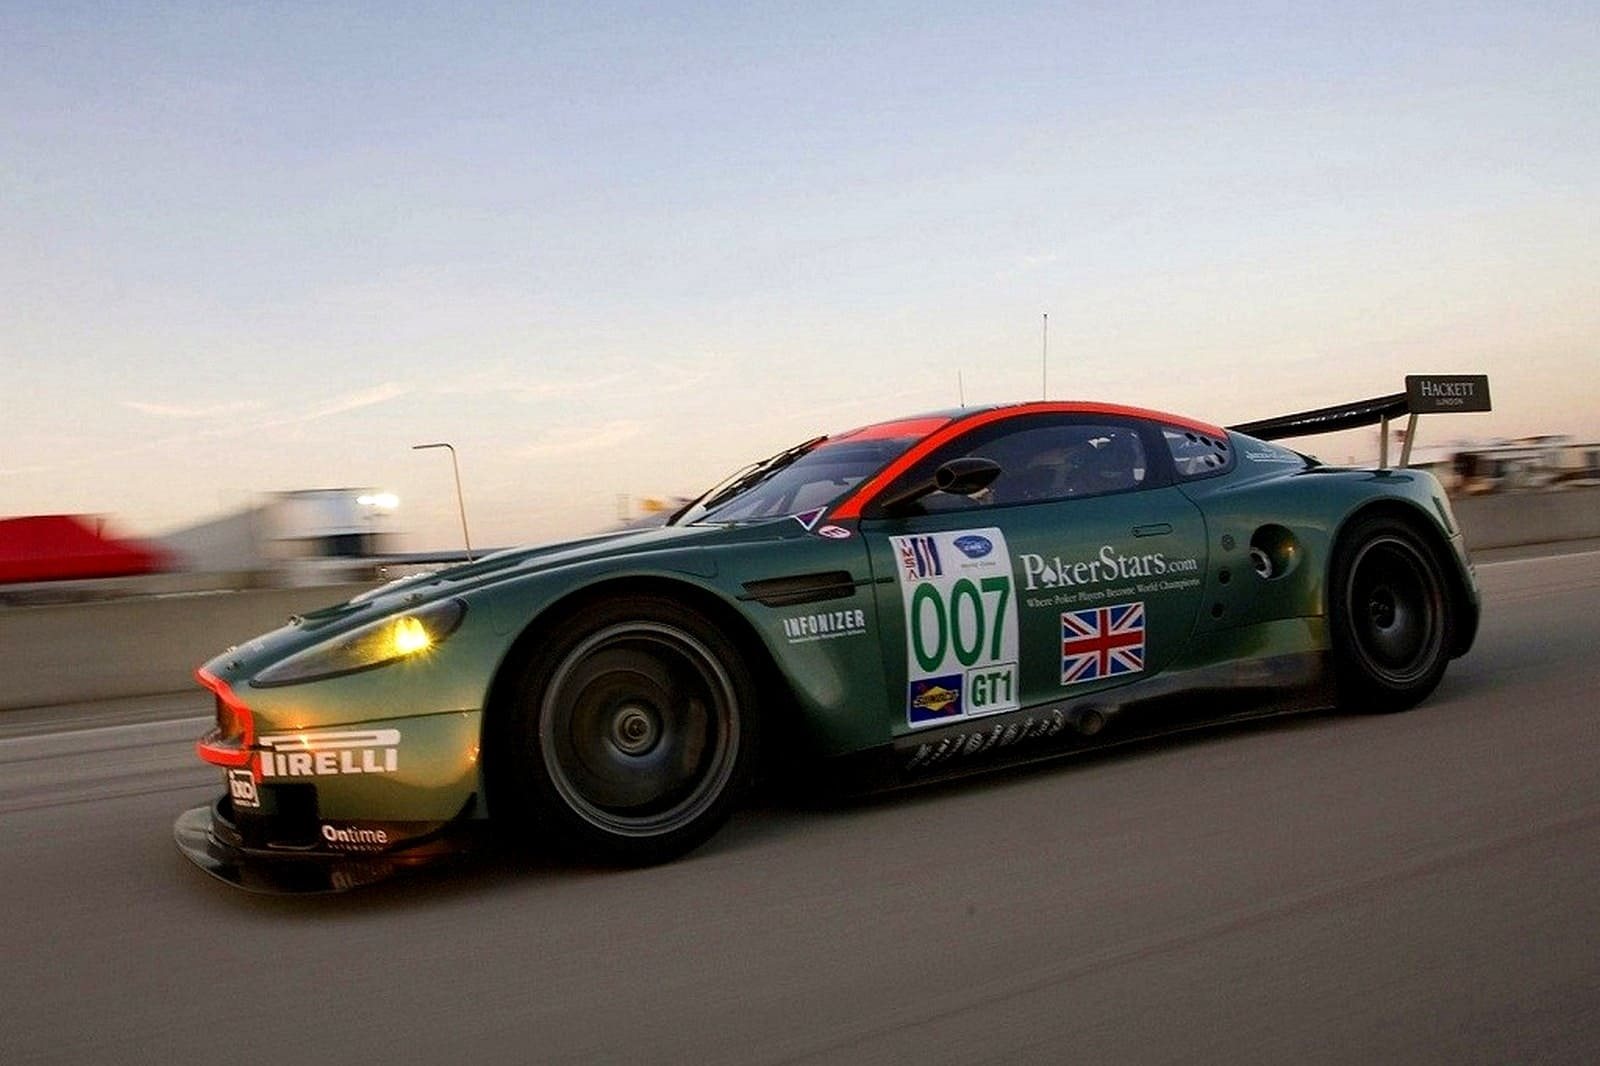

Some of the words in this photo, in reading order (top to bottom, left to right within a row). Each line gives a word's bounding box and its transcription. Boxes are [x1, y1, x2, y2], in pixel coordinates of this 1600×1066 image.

[1421, 380, 1475, 396] HACKETT
[784, 609, 865, 637] INFONIZER
[911, 576, 1010, 673] 007
[972, 670, 1012, 707] GT1
[258, 729, 401, 776] PIRELLI
[321, 825, 388, 843] Ontime
